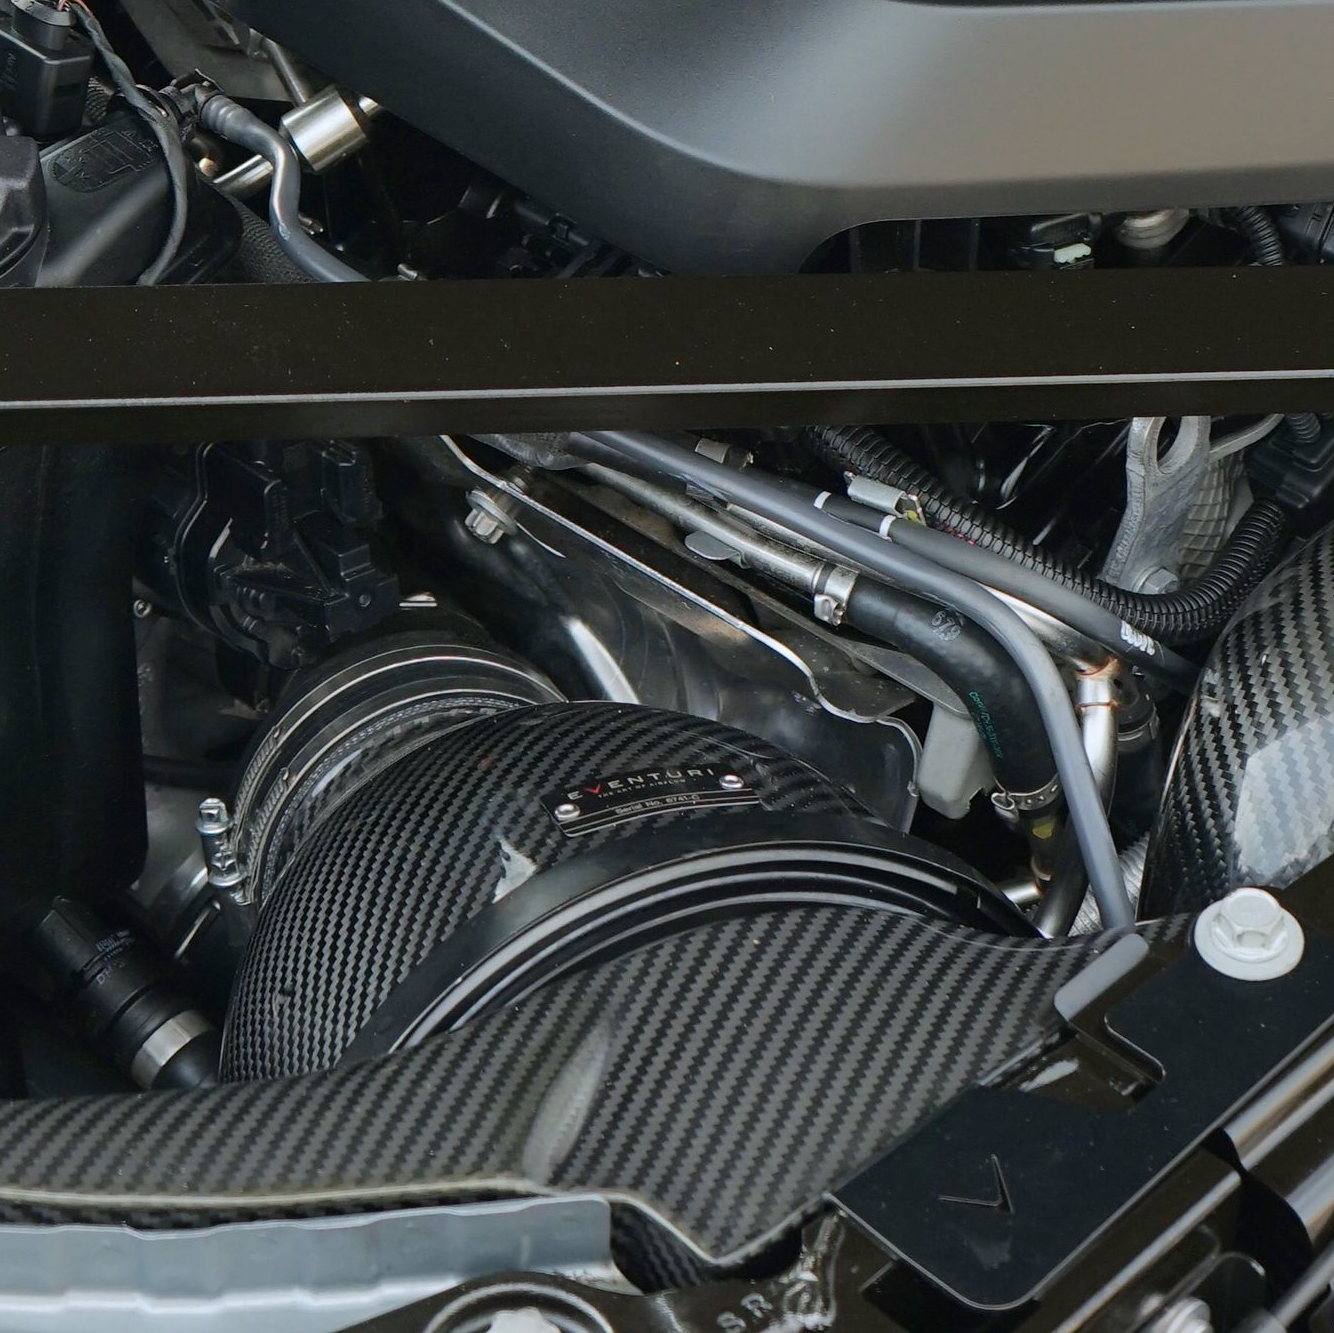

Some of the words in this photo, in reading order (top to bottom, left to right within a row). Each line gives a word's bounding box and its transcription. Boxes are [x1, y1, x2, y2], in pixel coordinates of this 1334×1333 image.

[567, 768, 715, 800] EVENTURI
[615, 802, 644, 814] Serial
[645, 799, 663, 809] No.
